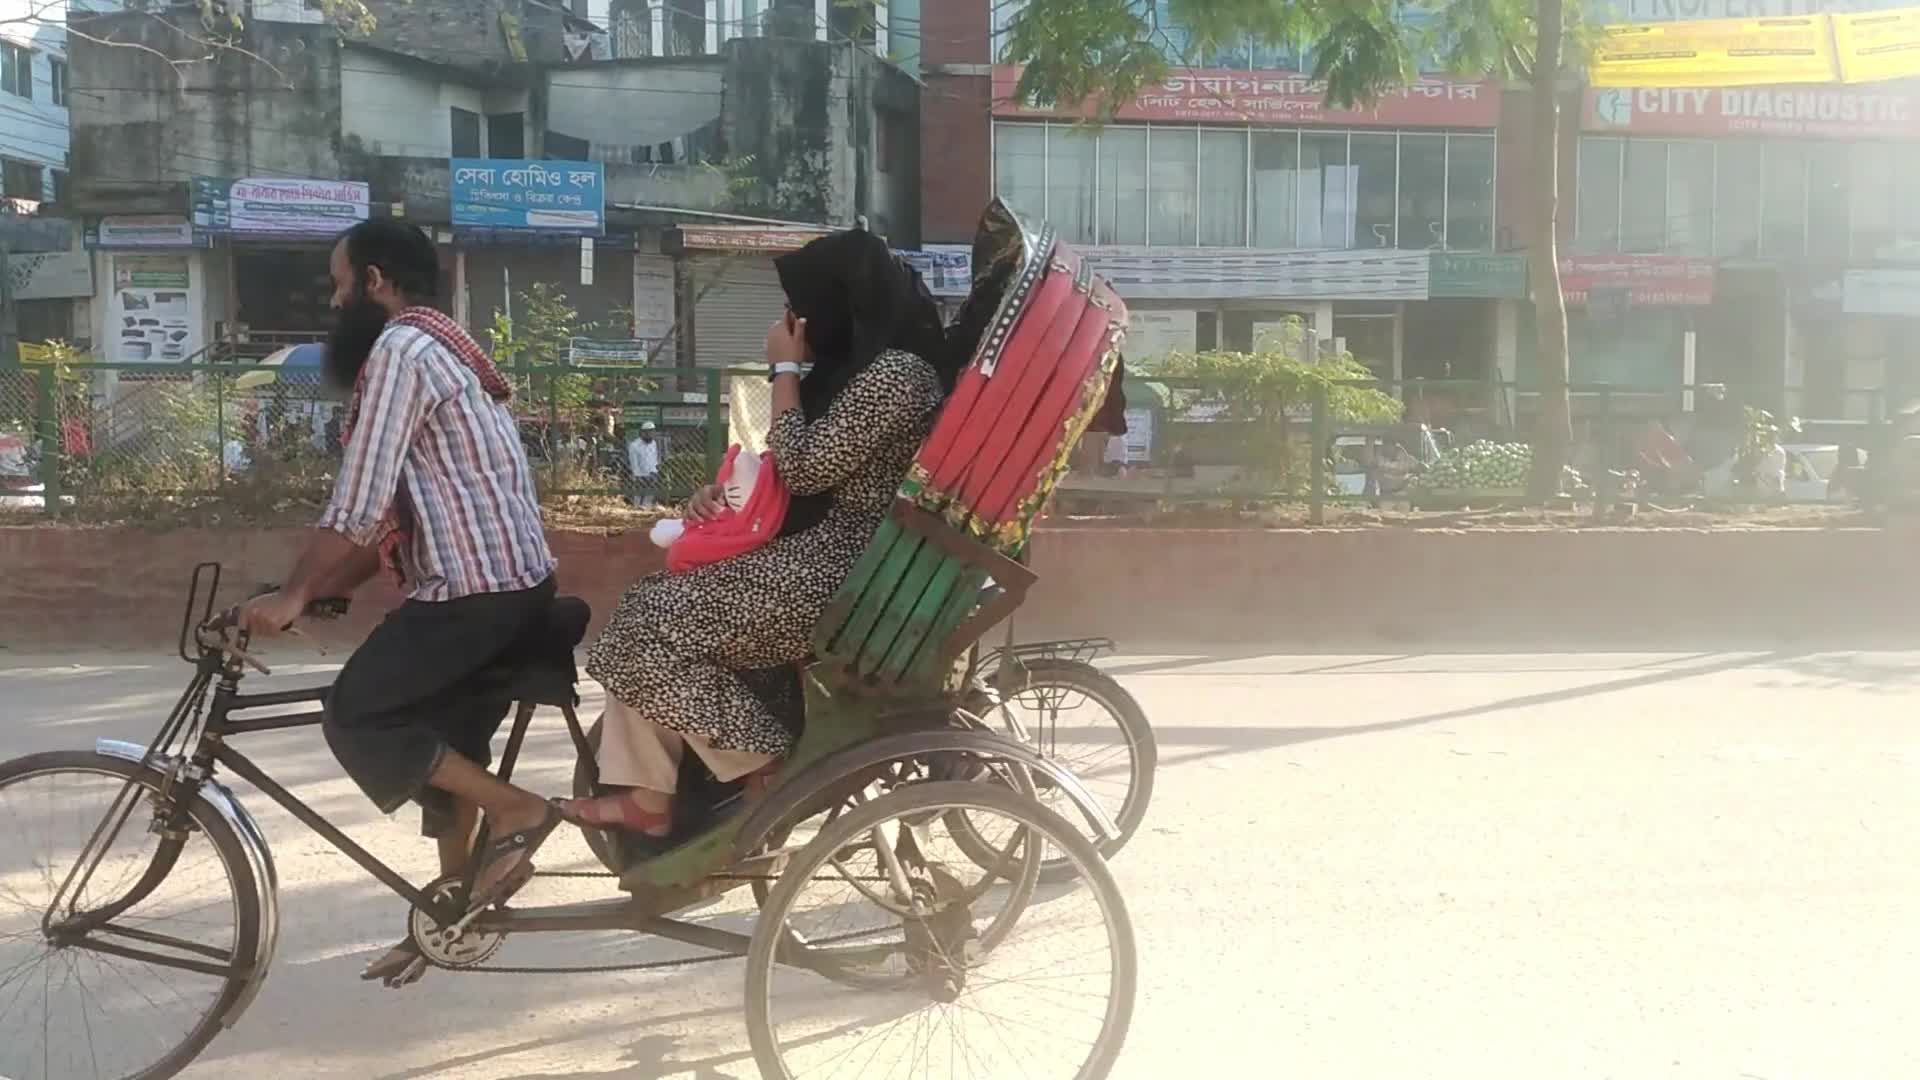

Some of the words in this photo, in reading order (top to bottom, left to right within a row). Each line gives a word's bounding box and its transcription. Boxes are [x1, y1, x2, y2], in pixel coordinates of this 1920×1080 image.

[1639, 88, 1712, 114] CITY
[1721, 90, 1908, 121] DIAGNOSTIC
[455, 167, 496, 185] সেবা
[502, 164, 562, 187] হোমিও
[568, 170, 598, 189] হল
